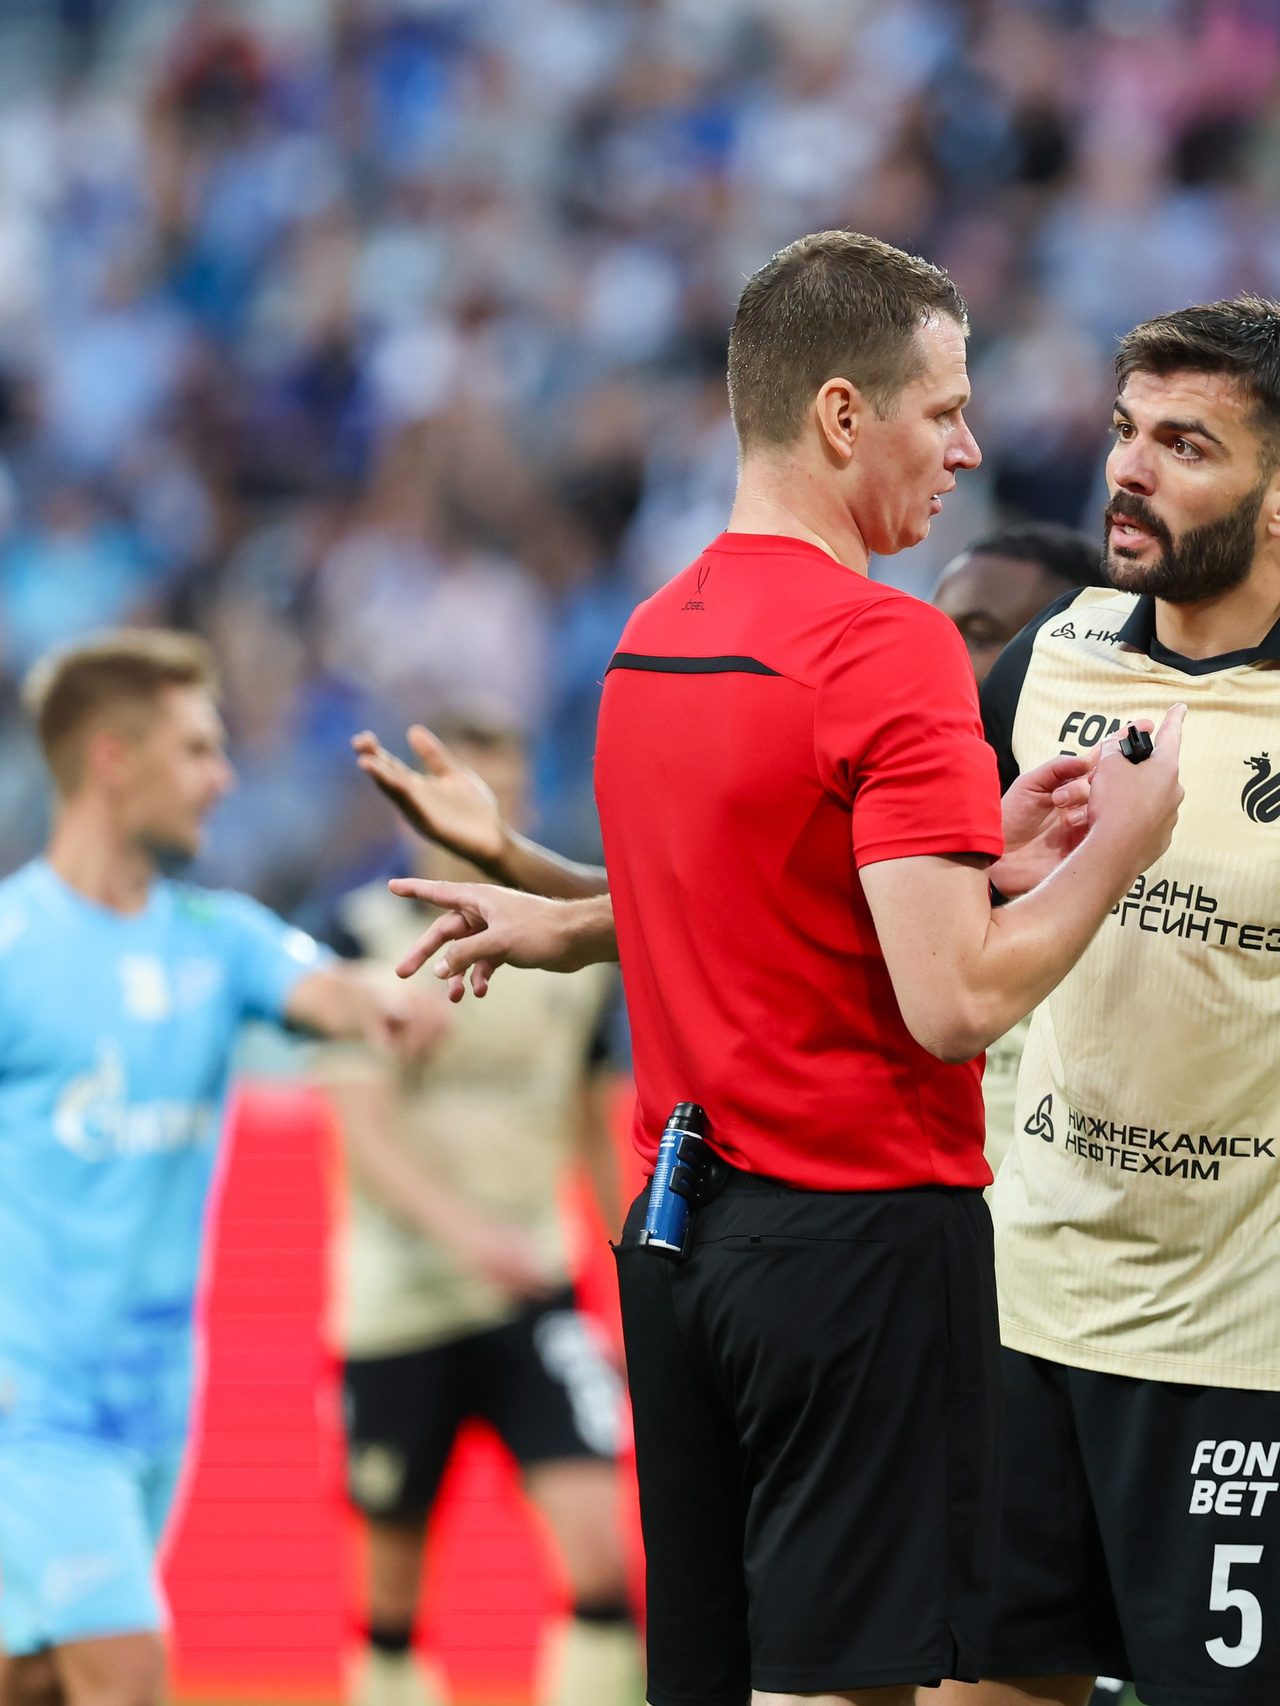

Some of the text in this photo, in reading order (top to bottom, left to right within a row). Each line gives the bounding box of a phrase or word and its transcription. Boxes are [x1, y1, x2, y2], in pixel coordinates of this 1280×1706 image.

[1126, 874, 1218, 914] ЗАНЬ
[1067, 1105, 1277, 1159] НИЖНЕКАМСК
[1065, 1132, 1221, 1182] НЕФТЕХИМ
[1190, 1440, 1280, 1477] FON
[1188, 1480, 1280, 1517] BET
[1204, 1543, 1265, 1669] 5
